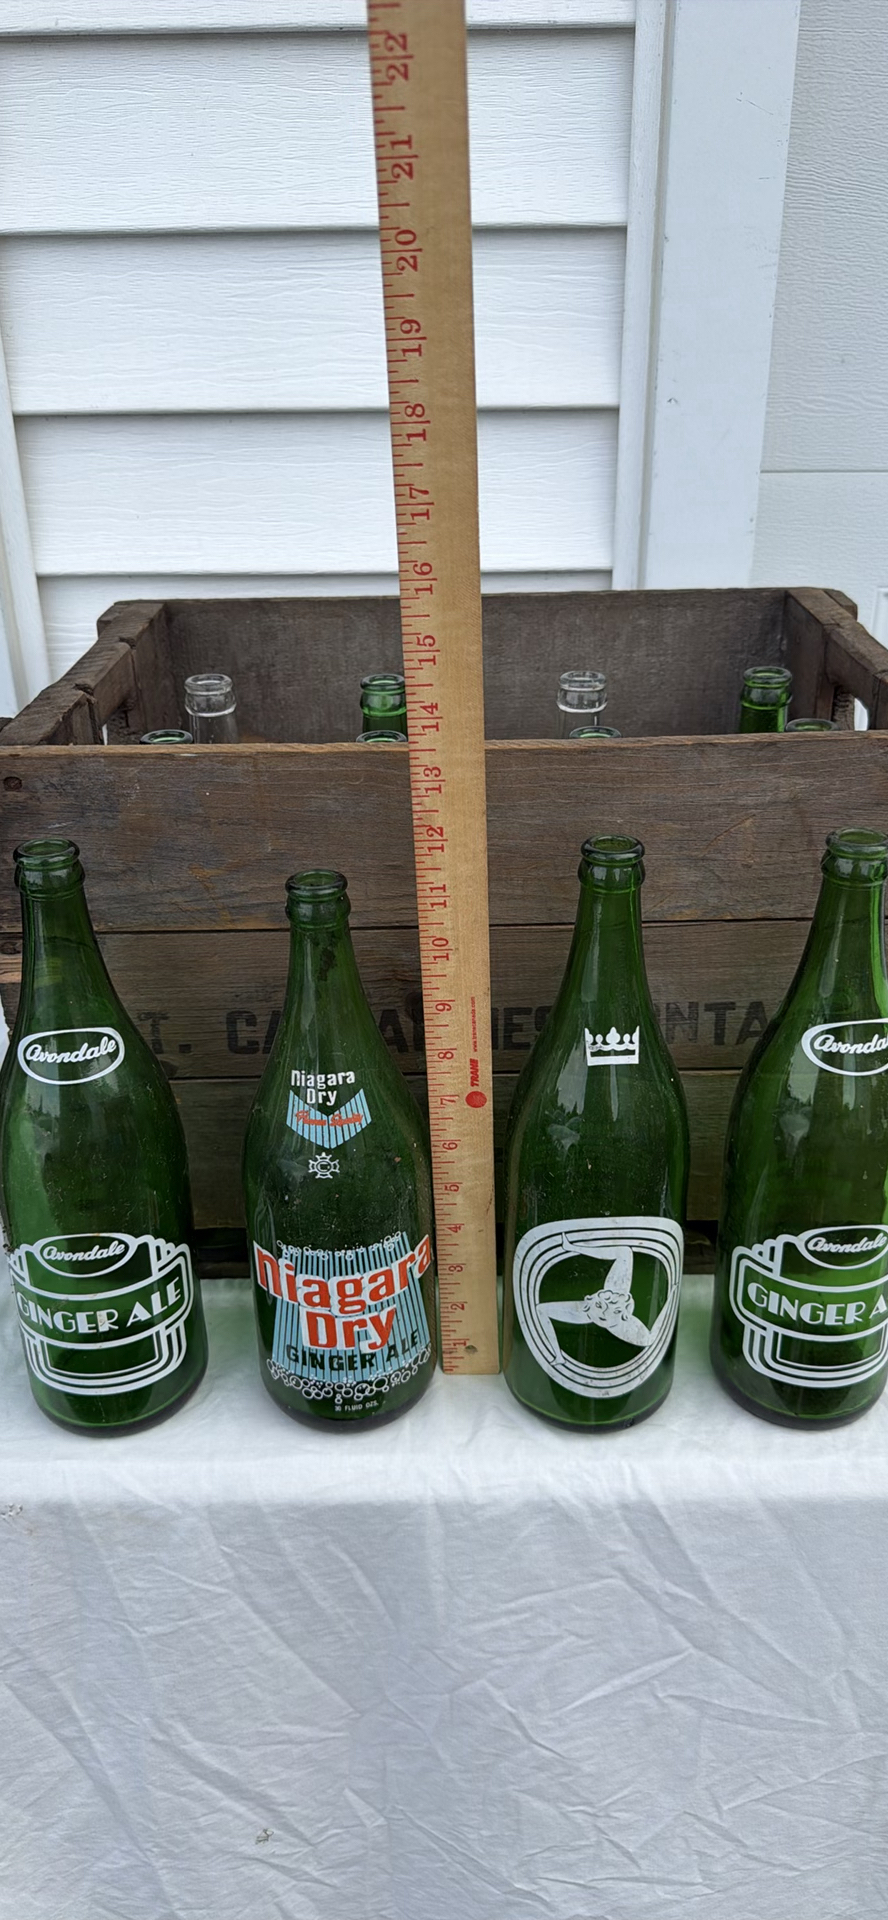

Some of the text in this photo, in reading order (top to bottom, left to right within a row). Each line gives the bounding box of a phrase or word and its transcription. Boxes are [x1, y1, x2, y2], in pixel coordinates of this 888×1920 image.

[384, 32, 409, 81] 22
[389, 134, 414, 180] 21
[394, 229, 418, 272] 20
[400, 318, 423, 358] 19
[404, 403, 427, 442] 18
[409, 486, 431, 521] 17
[413, 561, 434, 595] 16
[416, 634, 437, 666] 15
[420, 702, 439, 732] 14
[423, 766, 443, 795] 13
[426, 826, 445, 853] 12
[429, 884, 447, 909] 11
[431, 937, 450, 962] 10
[435, 1002, 452, 1012] 9
[26, 1036, 117, 1063] Avondale
[437, 1051, 454, 1060] 8
[291, 1069, 356, 1090] Niagara
[469, 1057, 479, 1087] TRANE
[306, 1088, 337, 1106] Dry
[440, 1096, 456, 1106] 7
[442, 1141, 458, 1151] 6
[444, 1183, 460, 1192] 5
[446, 1224, 462, 1233] 4
[43, 1240, 125, 1261] Avondale
[807, 1232, 887, 1253] Avondale
[448, 1264, 464, 1273] 3
[17, 1276, 182, 1334] GINGER ALE
[450, 1302, 466, 1311] 2
[747, 1282, 866, 1326] GINGER
[302, 1304, 396, 1353] Dry
[286, 1329, 419, 1371] GINGER ALE
[452, 1340, 468, 1348] 1
[344, 1403, 363, 1411] FLUID
